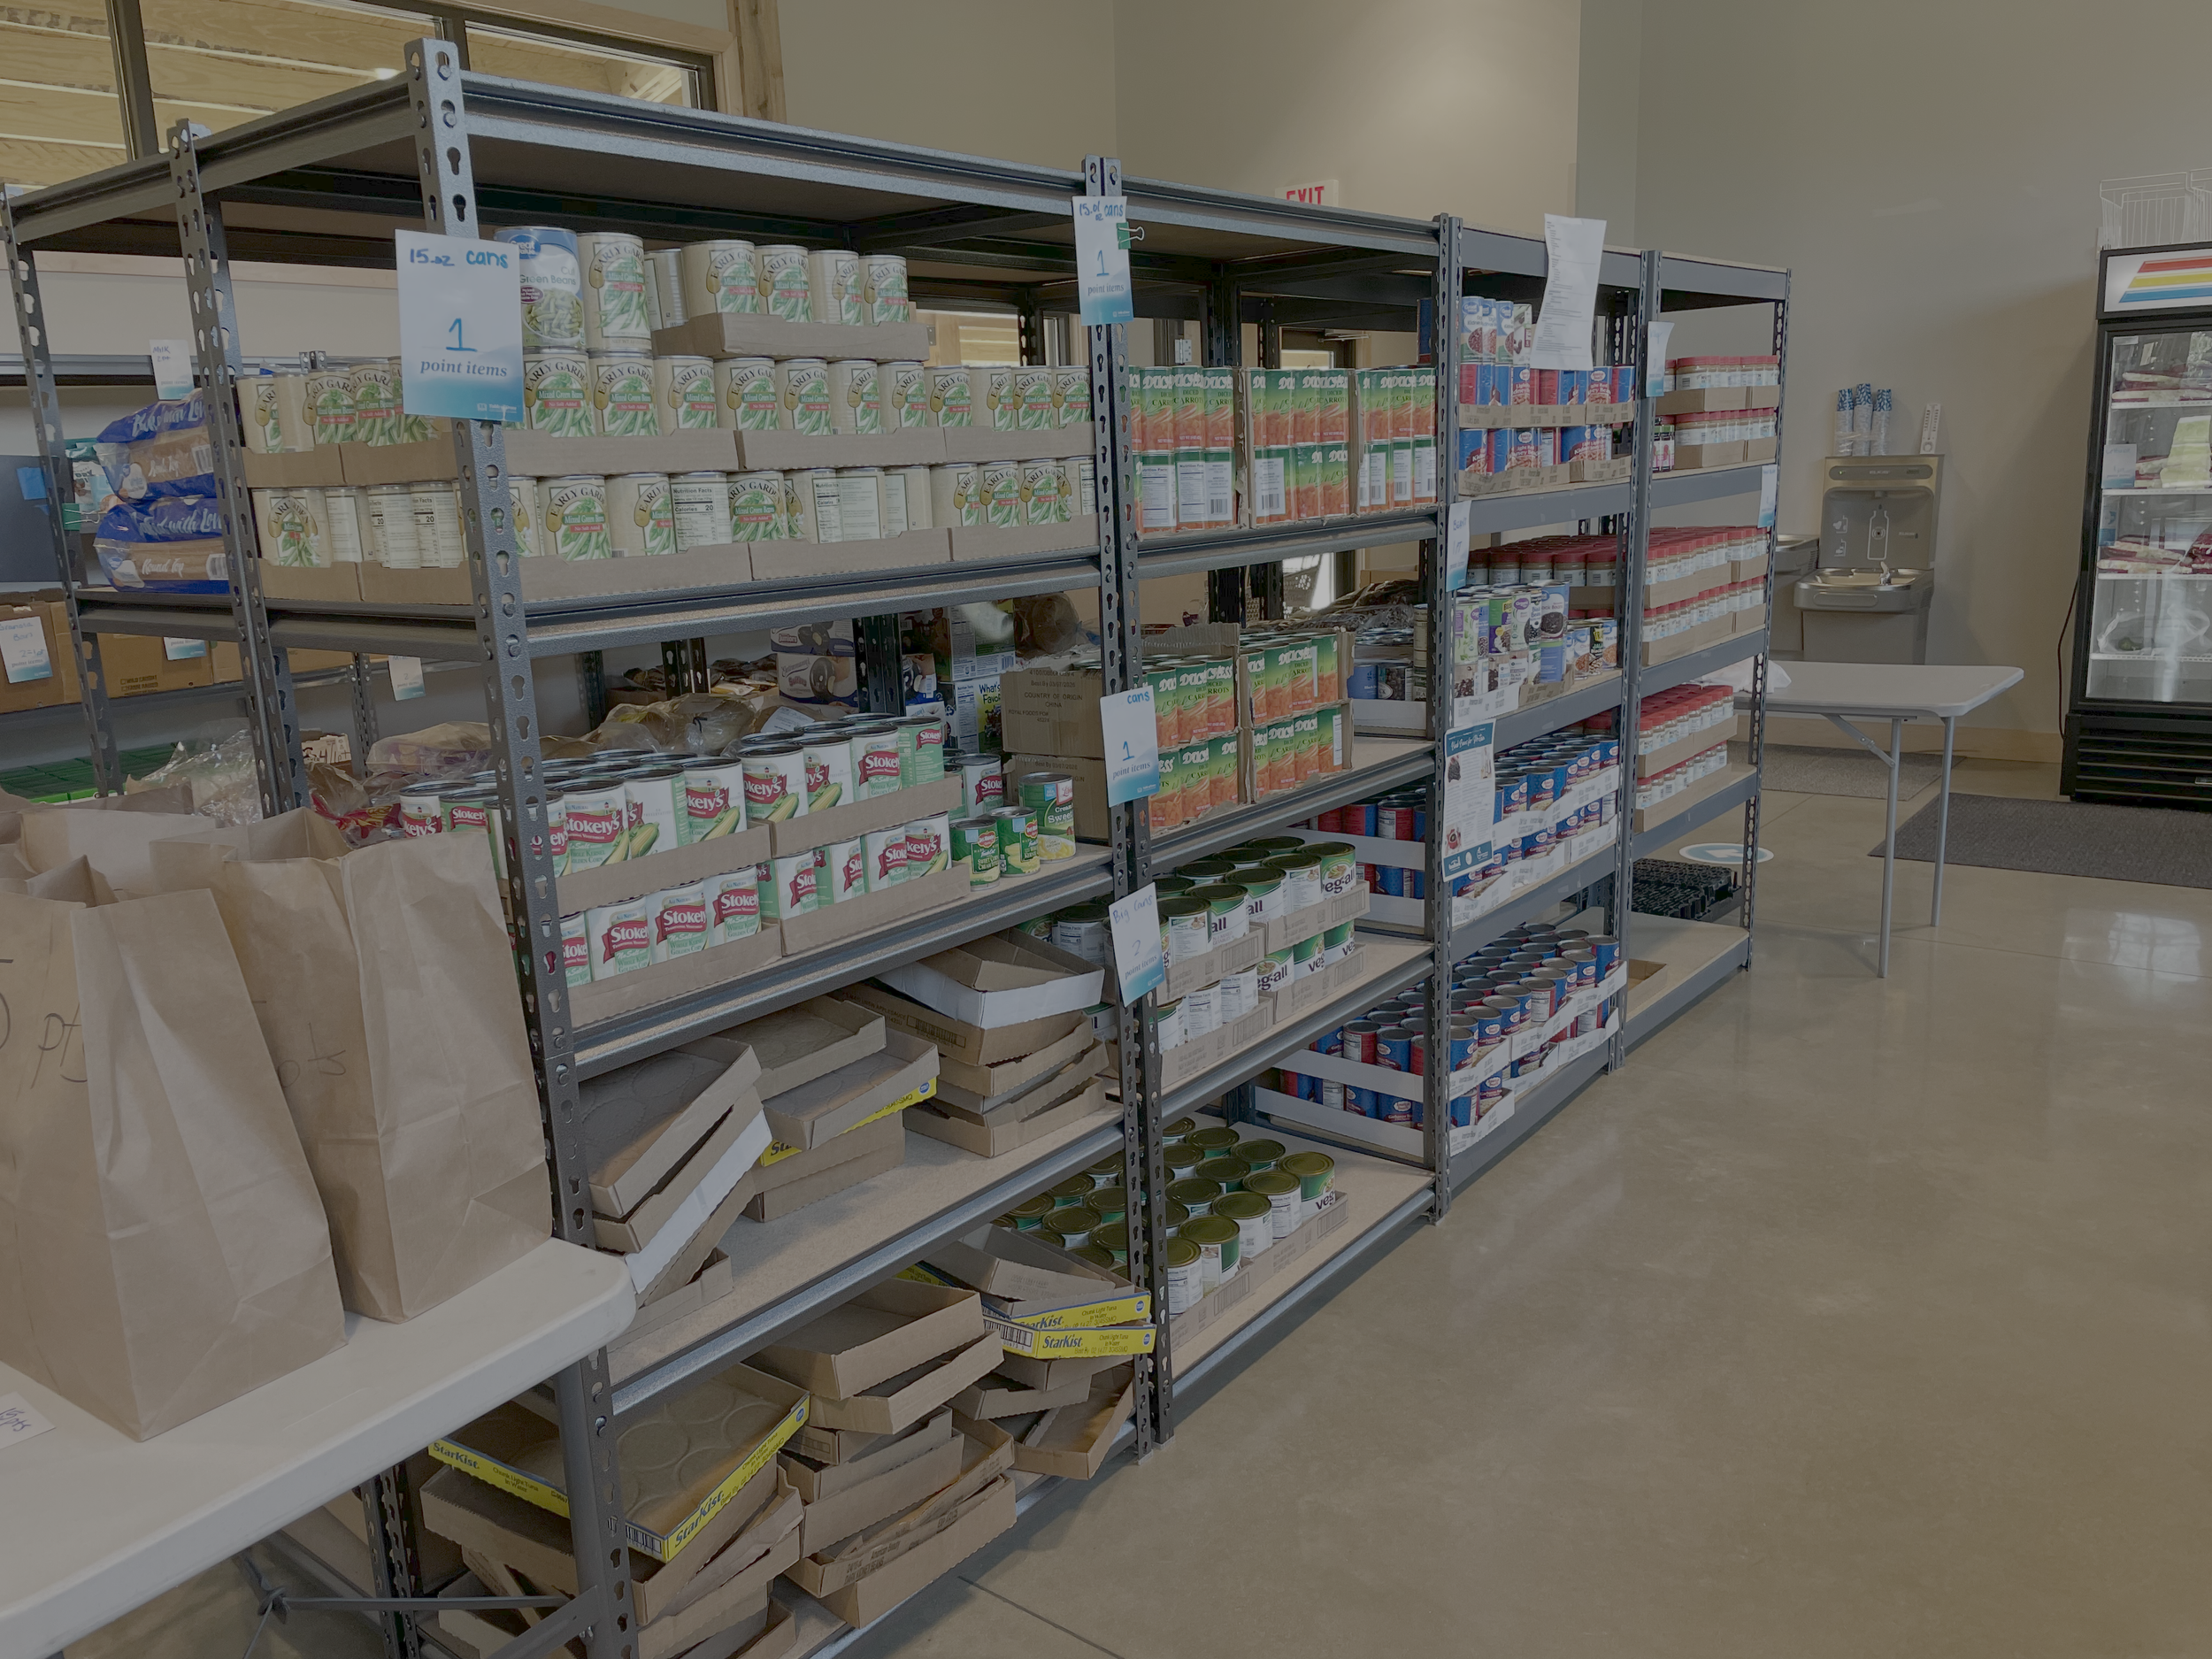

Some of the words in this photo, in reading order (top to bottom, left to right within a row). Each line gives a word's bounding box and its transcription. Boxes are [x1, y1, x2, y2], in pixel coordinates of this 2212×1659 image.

[1104, 202, 1124, 219] cans
[465, 250, 509, 269] cans
[1096, 250, 1110, 277] 1
[550, 275, 576, 285] Beans
[1087, 285, 1105, 297] point
[1106, 284, 1125, 293] items
[445, 318, 478, 352] 1
[420, 358, 462, 374] point
[465, 362, 508, 378] items
[526, 364, 552, 393] EARLY
[597, 366, 625, 396] EARLY
[188, 401, 204, 422] Lov
[1025, 469, 1044, 491] EARLY
[550, 488, 578, 517] EARLY
[729, 482, 747, 505] ARLY
[200, 509, 222, 533] Lov
[1127, 691, 1150, 704] cans
[1122, 741, 1135, 761] 1
[1112, 767, 1130, 780] point
[1131, 763, 1151, 772] items
[744, 777, 782, 795] okely's
[981, 780, 1002, 790] Stoke
[687, 789, 724, 811] kely's
[1048, 811, 1073, 823] Sweet
[906, 840, 937, 856] kely's
[721, 894, 758, 909] Stokel
[1112, 909, 1130, 924] Big
[1133, 894, 1153, 910] Cans
[611, 926, 649, 943] Stokel
[1132, 940, 1141, 956] 2
[1125, 964, 1141, 980] point
[1141, 955, 1157, 969] items
[1042, 1334, 1083, 1348] StarKist
[433, 1442, 480, 1470] StarKist
[674, 1490, 725, 1548] StarKist
